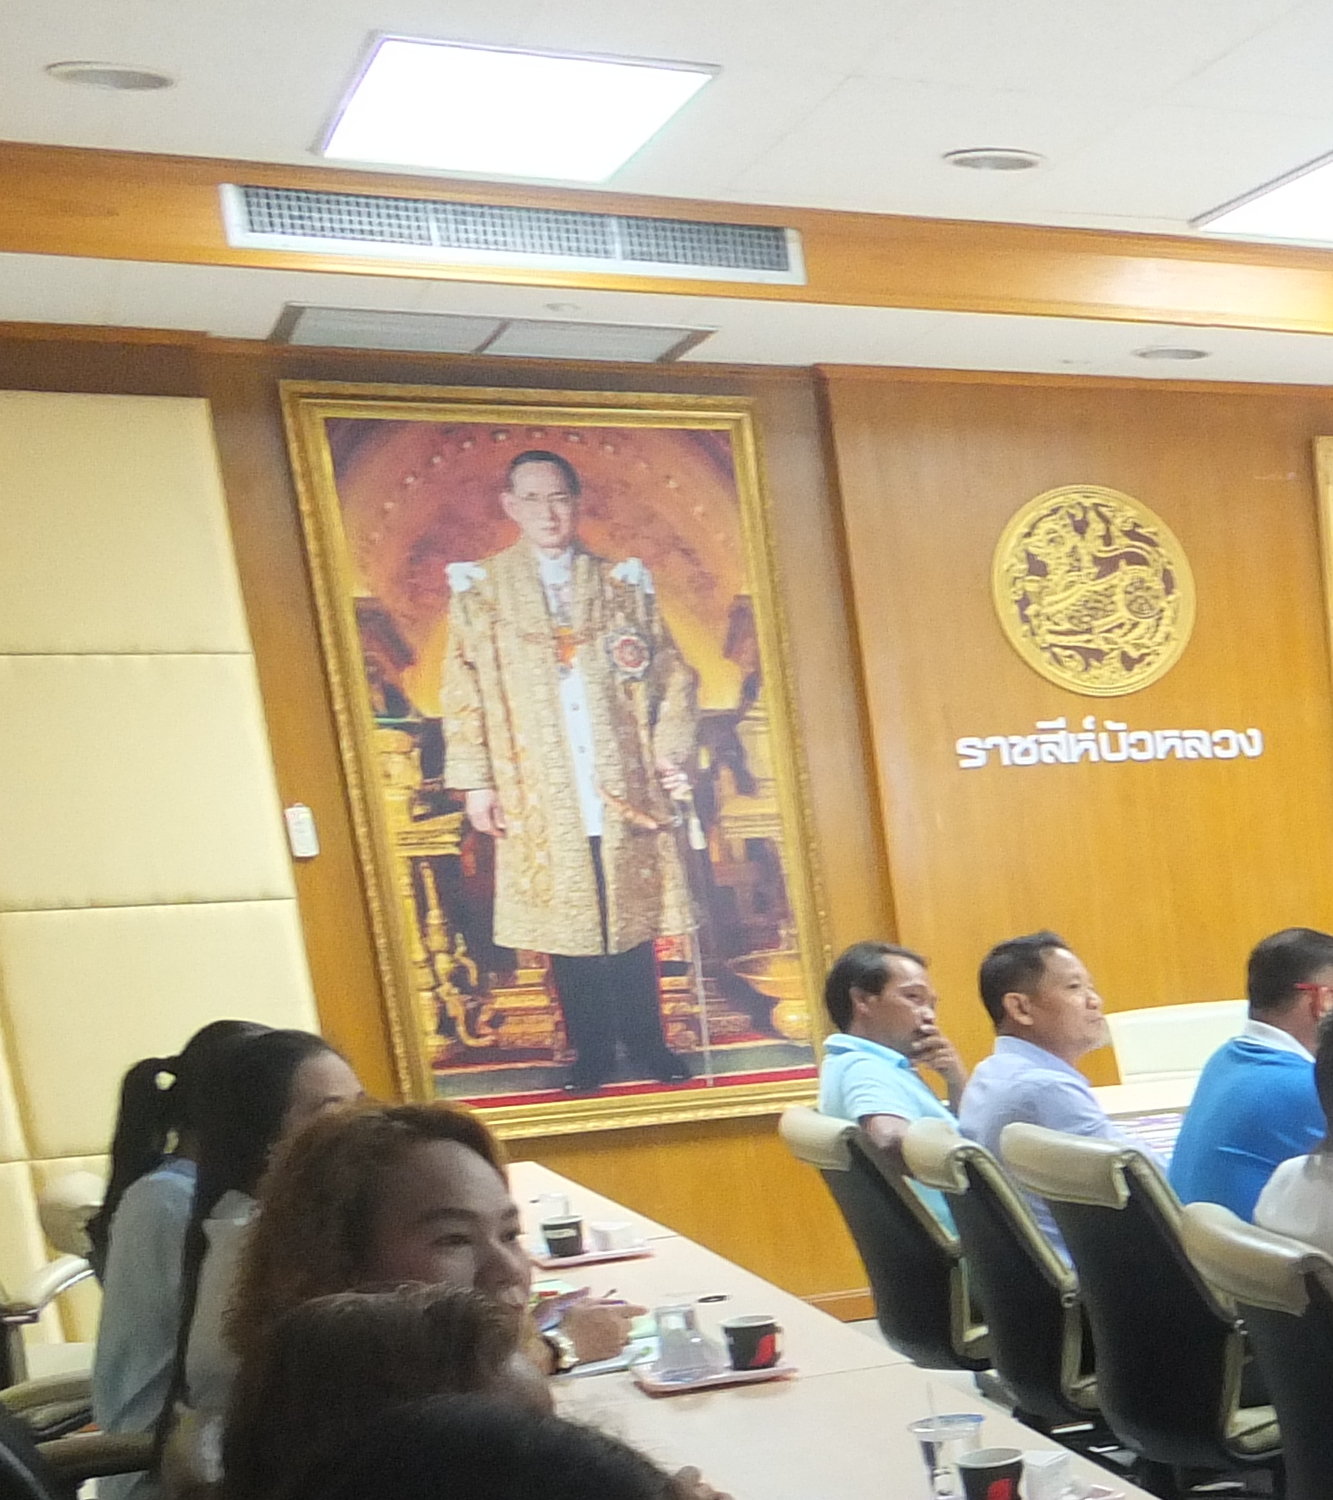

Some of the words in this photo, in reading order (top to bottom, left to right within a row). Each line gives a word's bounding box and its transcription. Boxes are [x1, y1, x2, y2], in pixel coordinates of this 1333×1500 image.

[956, 715, 1264, 769] ราชสีห์บัวหลวง
